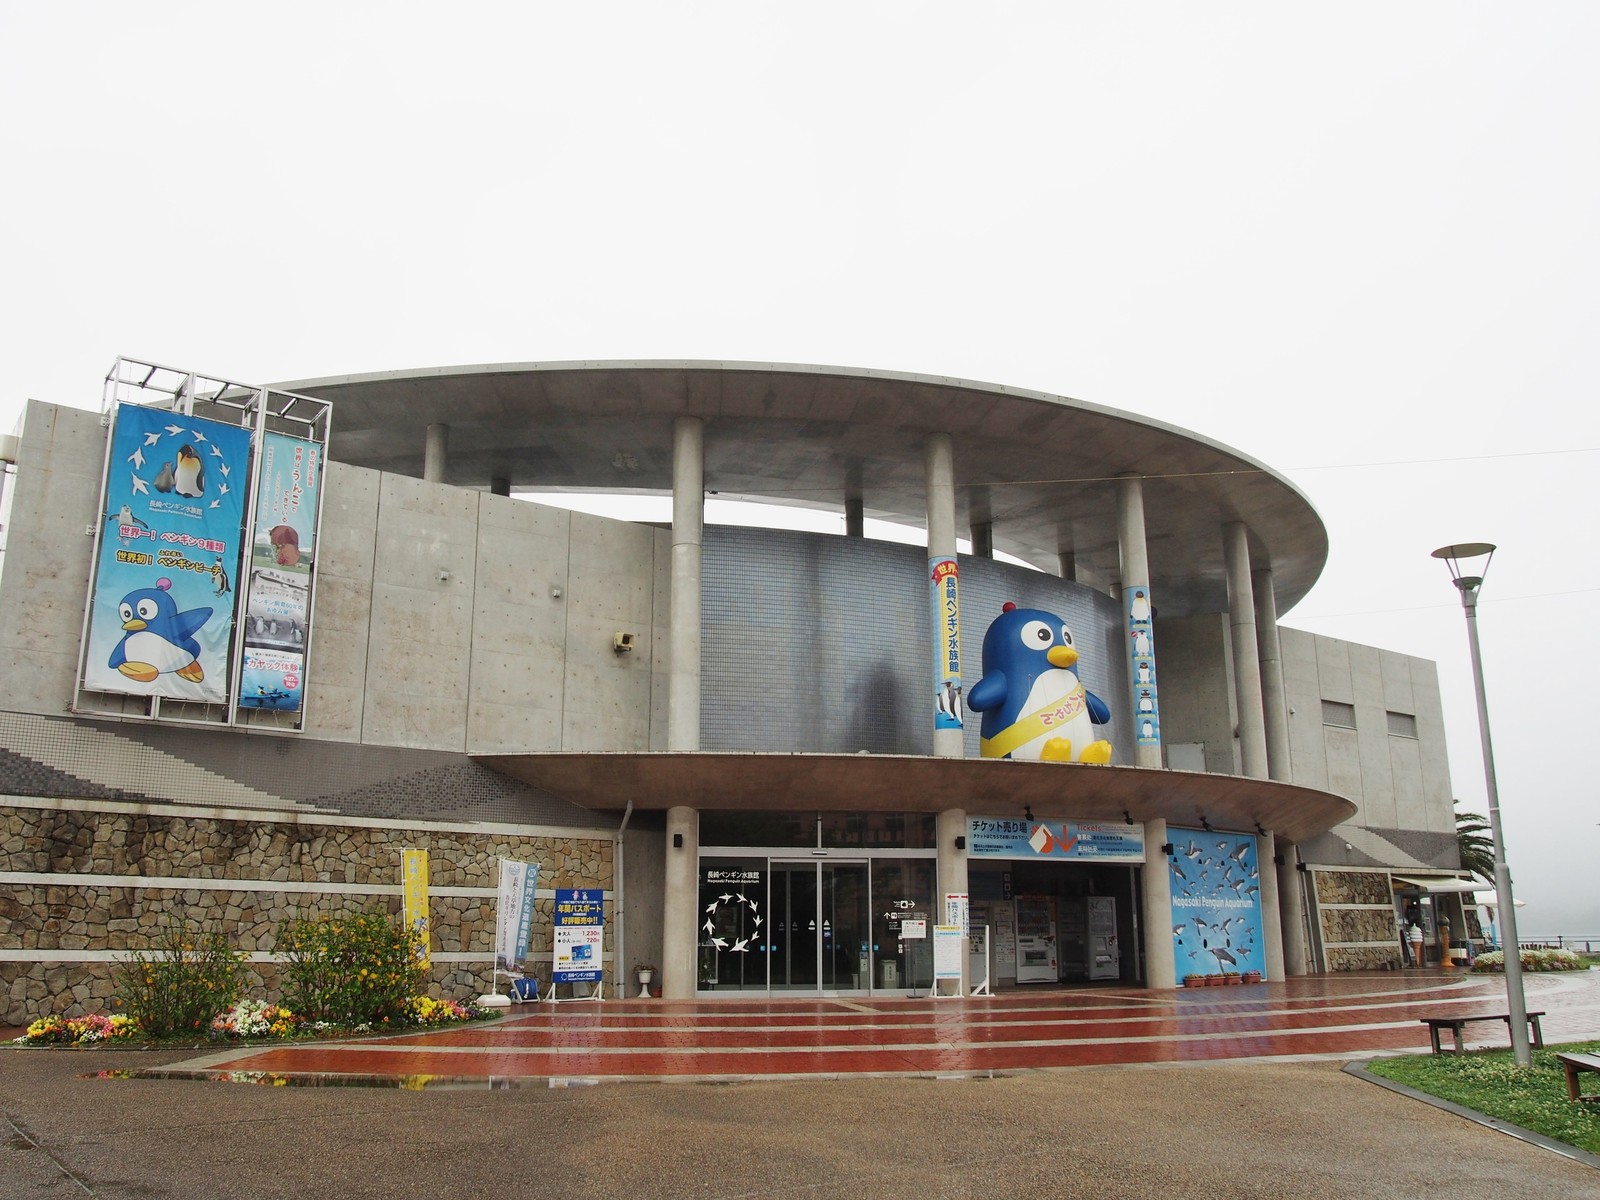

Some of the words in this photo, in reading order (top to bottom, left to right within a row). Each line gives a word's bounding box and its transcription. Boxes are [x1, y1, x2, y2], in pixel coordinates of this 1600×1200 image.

[157, 557, 221, 575] ペンギンビーチ
[946, 577, 960, 673] 長崎ペンギン水族館
[248, 659, 299, 672] カヤック体験
[972, 820, 1028, 833] チケット売り場
[707, 871, 760, 879] 長崎ペンギン水族館
[558, 904, 602, 913] 年間パスポート
[1172, 896, 1201, 909] Nagasaki
[1201, 896, 1224, 910] Penguin
[1225, 898, 1253, 910] Aquarium
